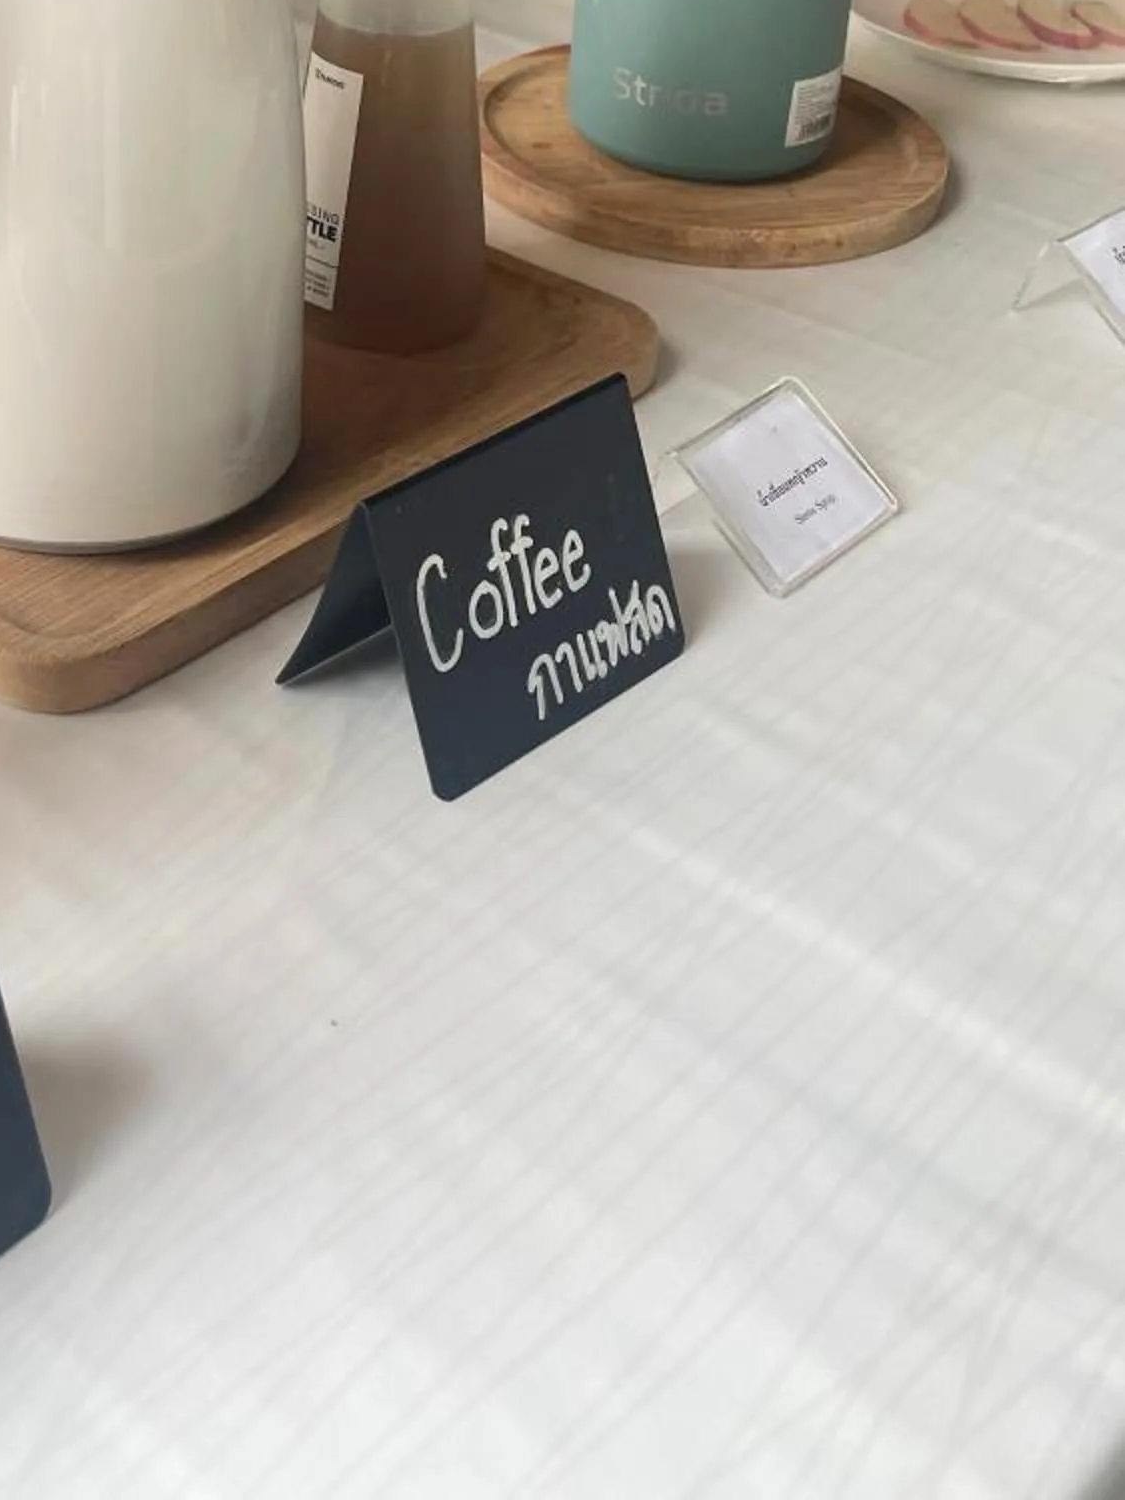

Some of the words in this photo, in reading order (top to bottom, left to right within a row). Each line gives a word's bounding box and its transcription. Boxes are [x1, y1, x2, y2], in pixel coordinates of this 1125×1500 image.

[306, 215, 338, 243] TLE
[416, 514, 591, 673] Coffee
[527, 579, 676, 721] กาแฟสด
